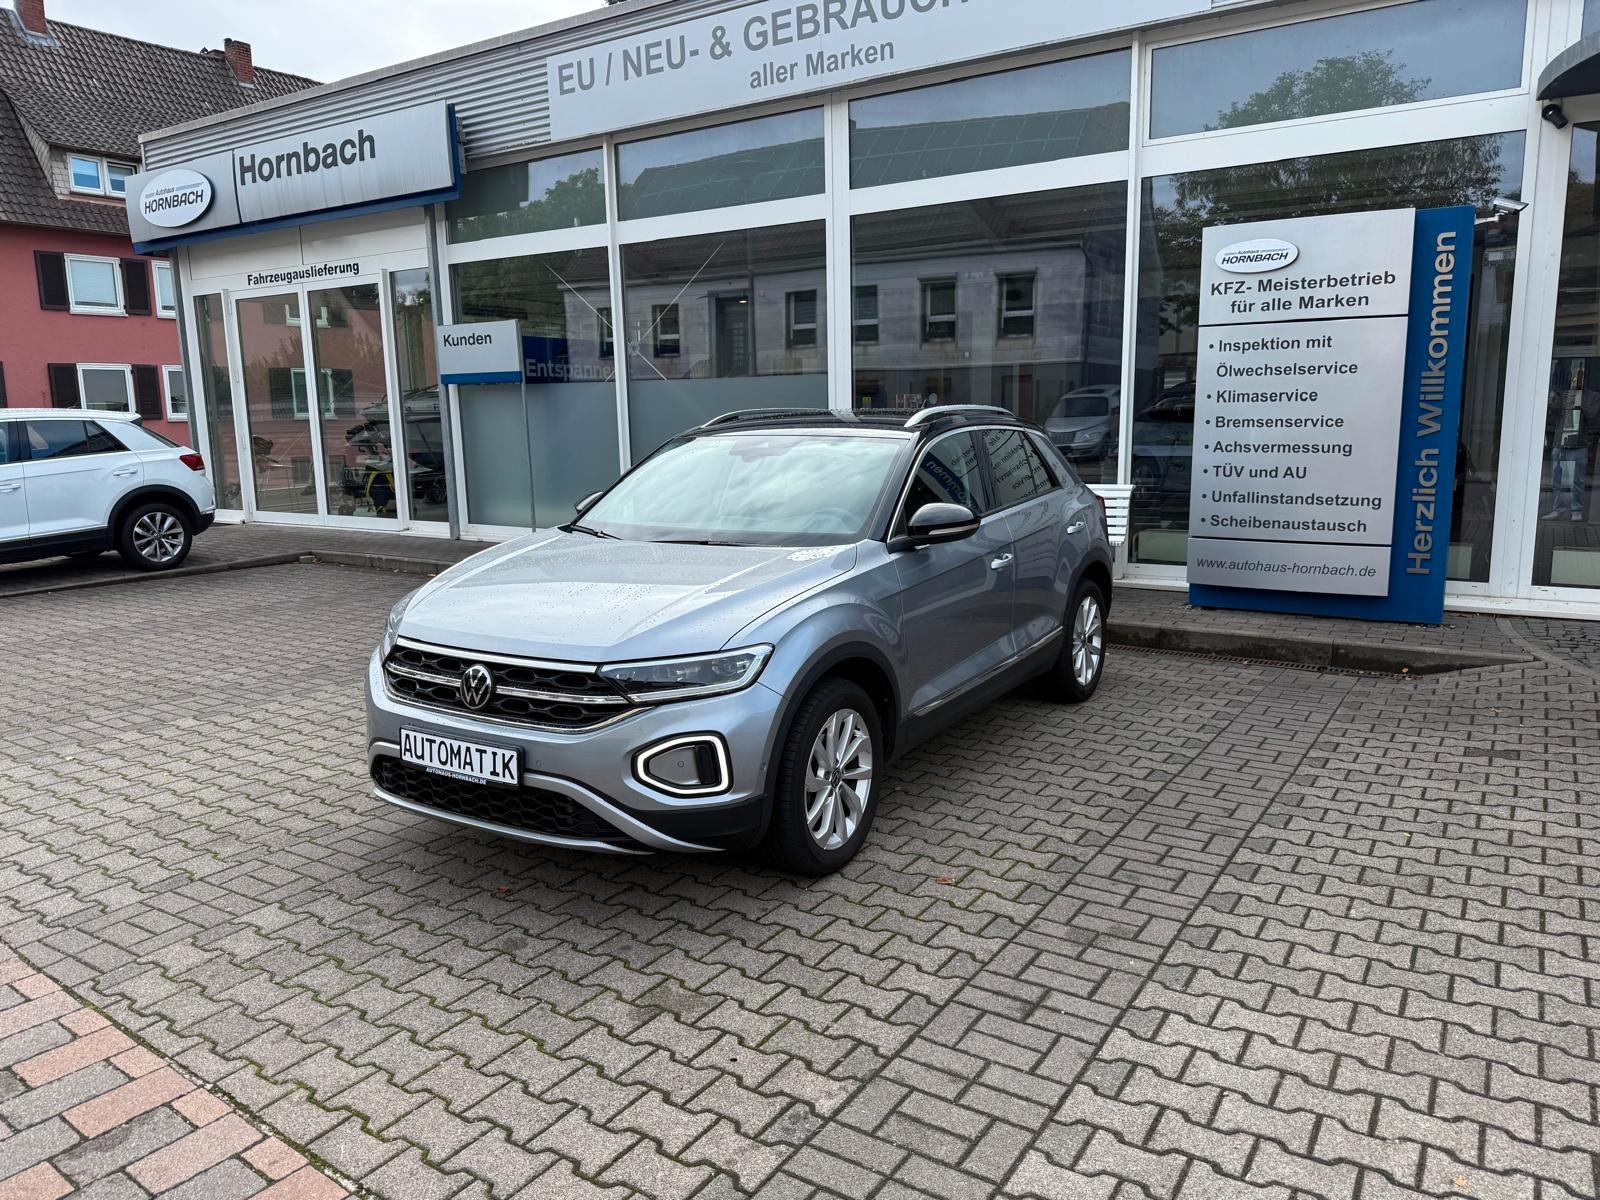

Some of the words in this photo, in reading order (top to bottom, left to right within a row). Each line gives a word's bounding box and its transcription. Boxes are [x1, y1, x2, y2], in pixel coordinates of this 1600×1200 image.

[557, 57, 595, 96] EU
[605, 52, 613, 86] /
[622, 35, 700, 82] NEU-
[709, 26, 733, 61] &
[743, 0, 970, 51] GEBRAU
[749, 61, 798, 90] aller
[805, 40, 896, 78] Marken
[238, 128, 376, 186] Hornbach
[143, 189, 204, 215] HORNBACH
[1221, 251, 1289, 265] HORNBACH
[247, 261, 360, 286] Fahrzeugauslieferung
[1210, 280, 1252, 296] KFZ-
[1257, 270, 1396, 293] Meisterbetrieb
[1230, 300, 1256, 314] für
[1260, 297, 1292, 312] alle
[1298, 293, 1370, 310] Marken
[442, 332, 493, 349] Kunden
[1218, 336, 1300, 354] Inspektion
[1306, 335, 1333, 349] mit
[1416, 231, 1457, 438] Willkommen
[1216, 361, 1359, 378] Ölwechselservice
[1216, 389, 1319, 403] Klimaservice
[1215, 414, 1345, 429] Bremsenservice
[1212, 440, 1353, 457] Achsvermessung
[1213, 462, 1245, 478] TÜV
[1249, 466, 1279, 479] und
[1282, 466, 1307, 479] AU
[1211, 490, 1382, 510] Unfallinstandsetzung
[1406, 448, 1440, 575] Herzlich
[1210, 514, 1368, 533] Scheibenaustausch
[1196, 558, 1377, 578] www.autohaus-hornbach.de
[403, 733, 516, 780] AUTOMATIK
[425, 766, 487, 785] AUTOHAUS-HORNBACH.DE
